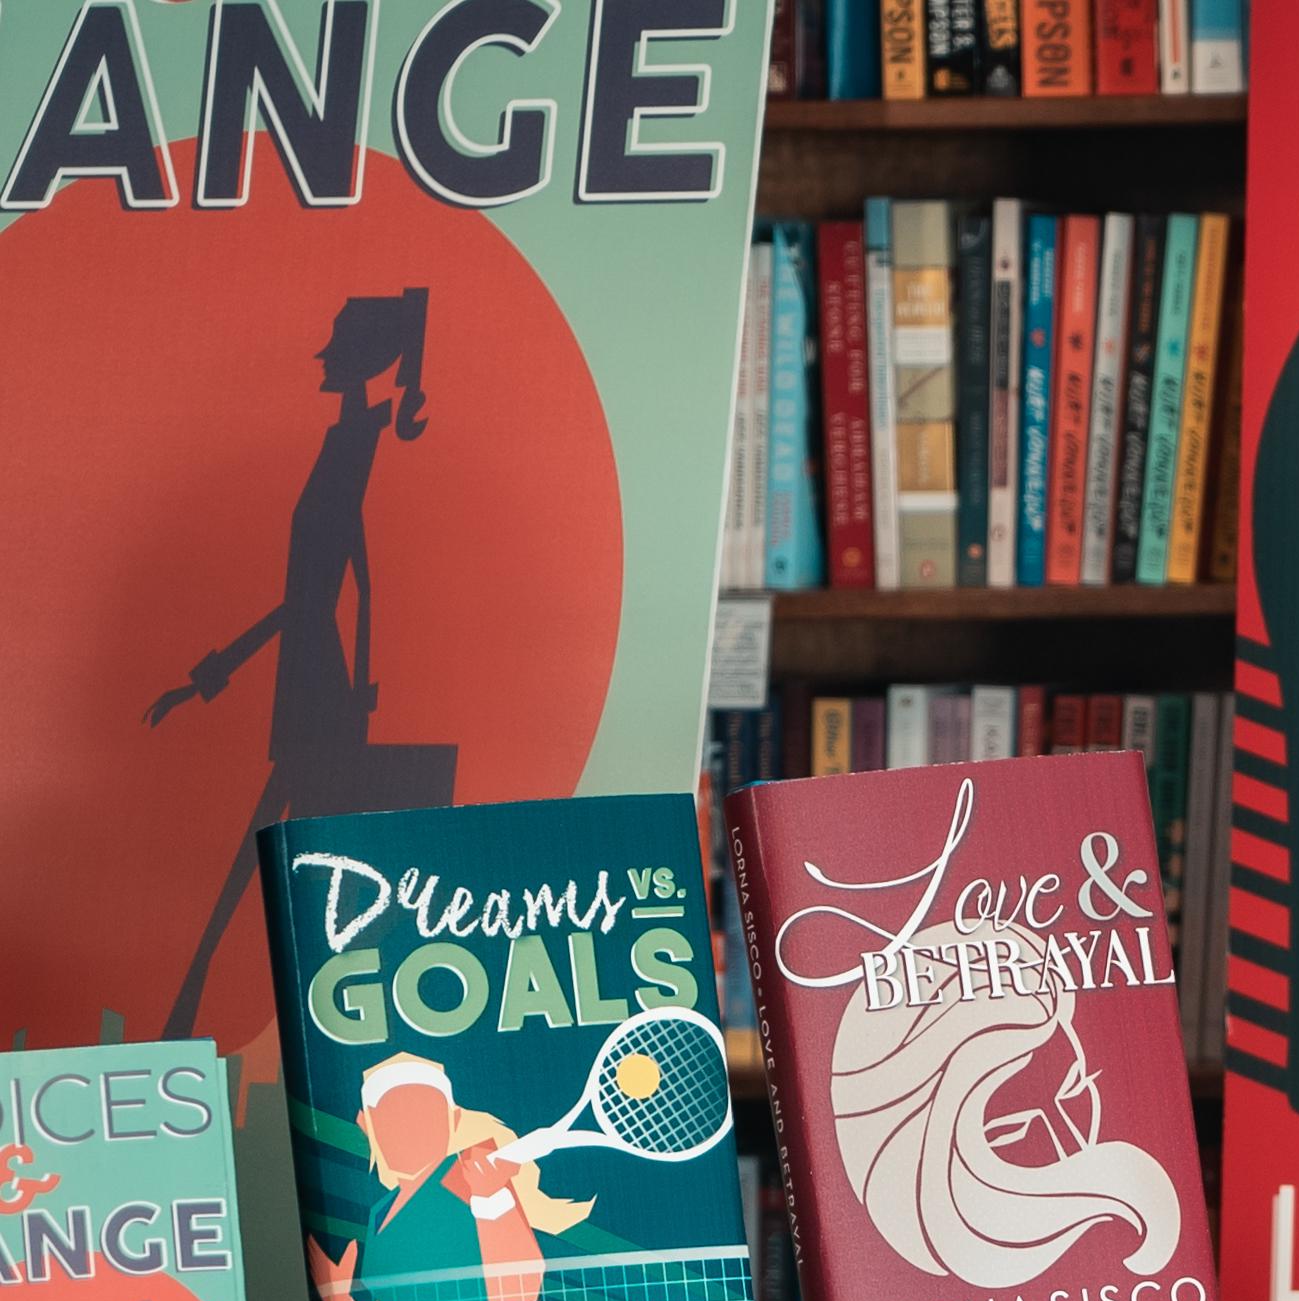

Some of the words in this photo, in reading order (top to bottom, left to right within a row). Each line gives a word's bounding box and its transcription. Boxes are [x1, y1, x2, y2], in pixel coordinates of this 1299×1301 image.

[292, 851, 627, 953] Dreams
[773, 777, 1065, 987] Love
[1077, 831, 1154, 922] &
[307, 926, 700, 1045] GOALS
[731, 825, 751, 906] LORNA
[743, 910, 764, 980] SISCO
[758, 1004, 777, 1071] LOVE
[859, 926, 1176, 1013] BETRAYAL
[0, 1066, 214, 1148] ICES
